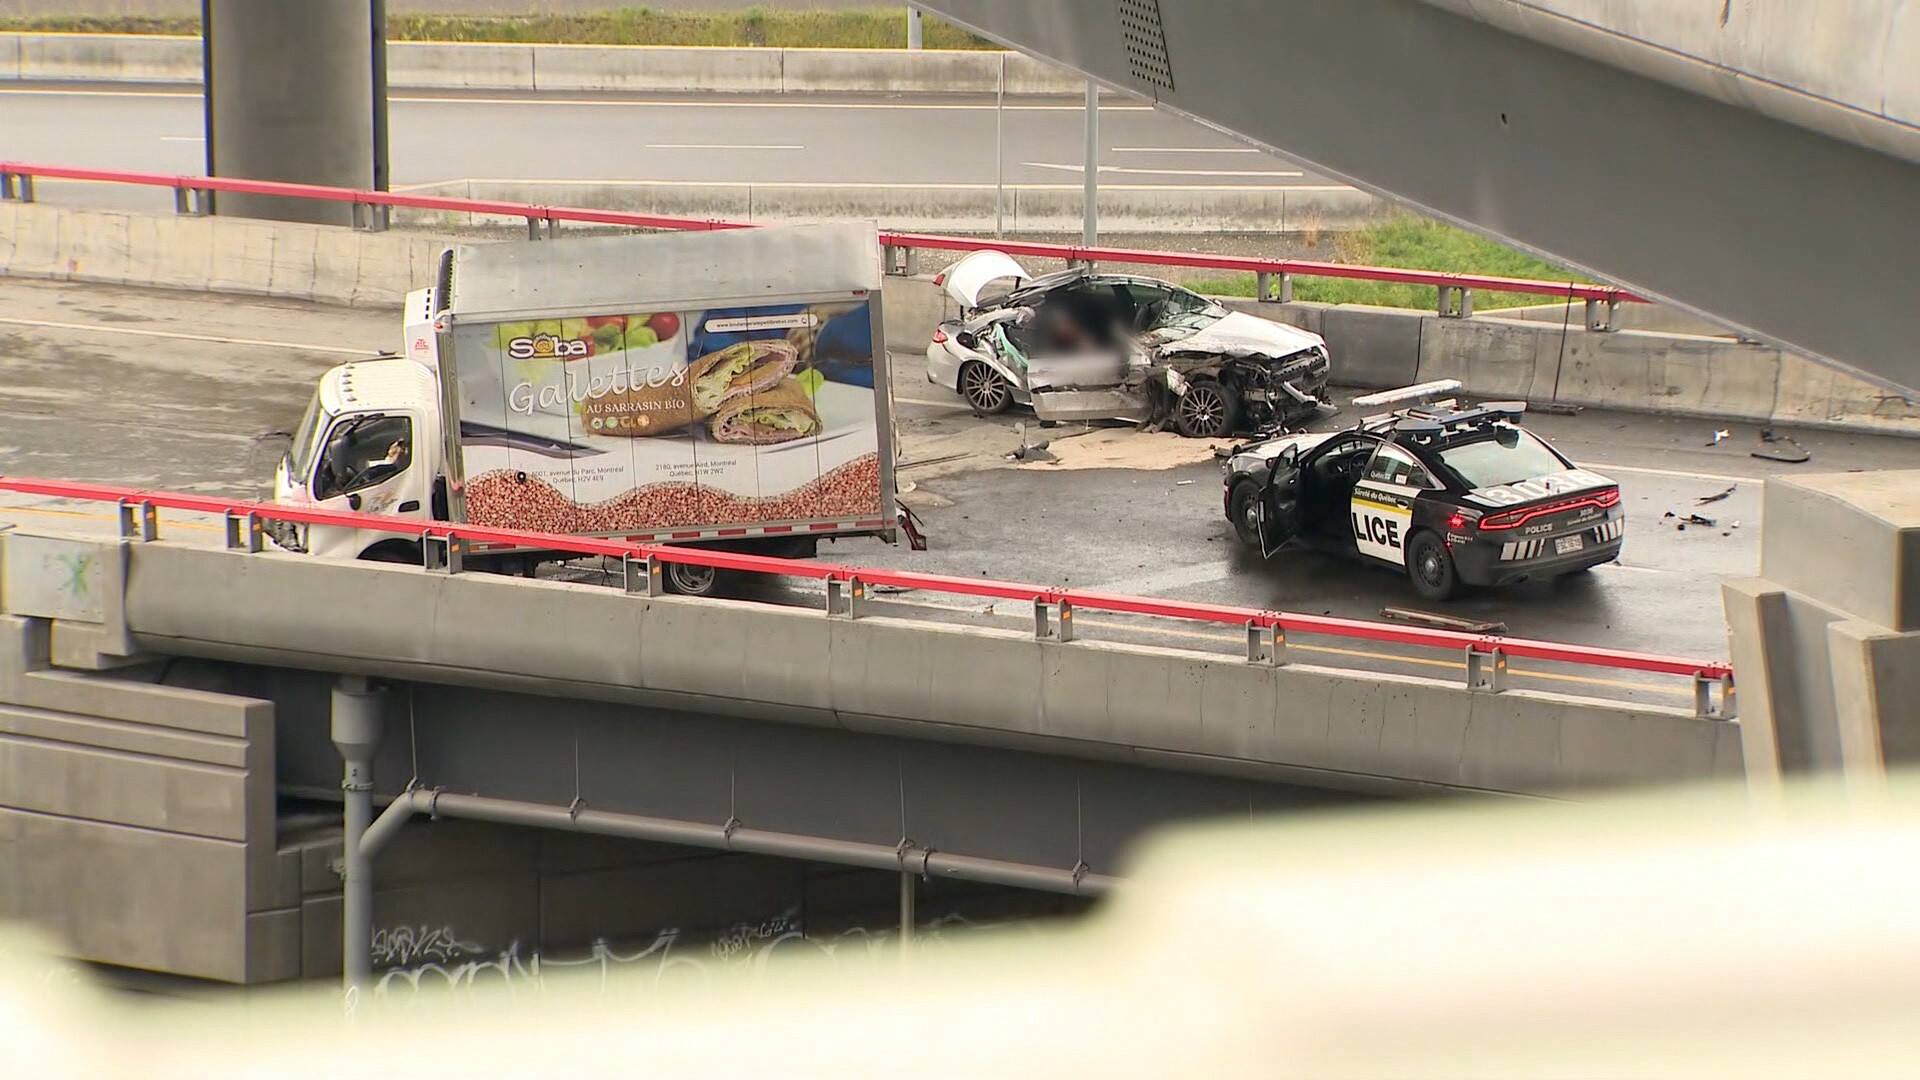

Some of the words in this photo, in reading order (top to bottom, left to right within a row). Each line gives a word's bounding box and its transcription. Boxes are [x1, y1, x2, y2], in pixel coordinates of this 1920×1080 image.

[509, 362, 690, 415] Galettes
[587, 405, 602, 413] AU
[604, 401, 662, 413] SARRASIN
[1525, 523, 1552, 534] POLICE
